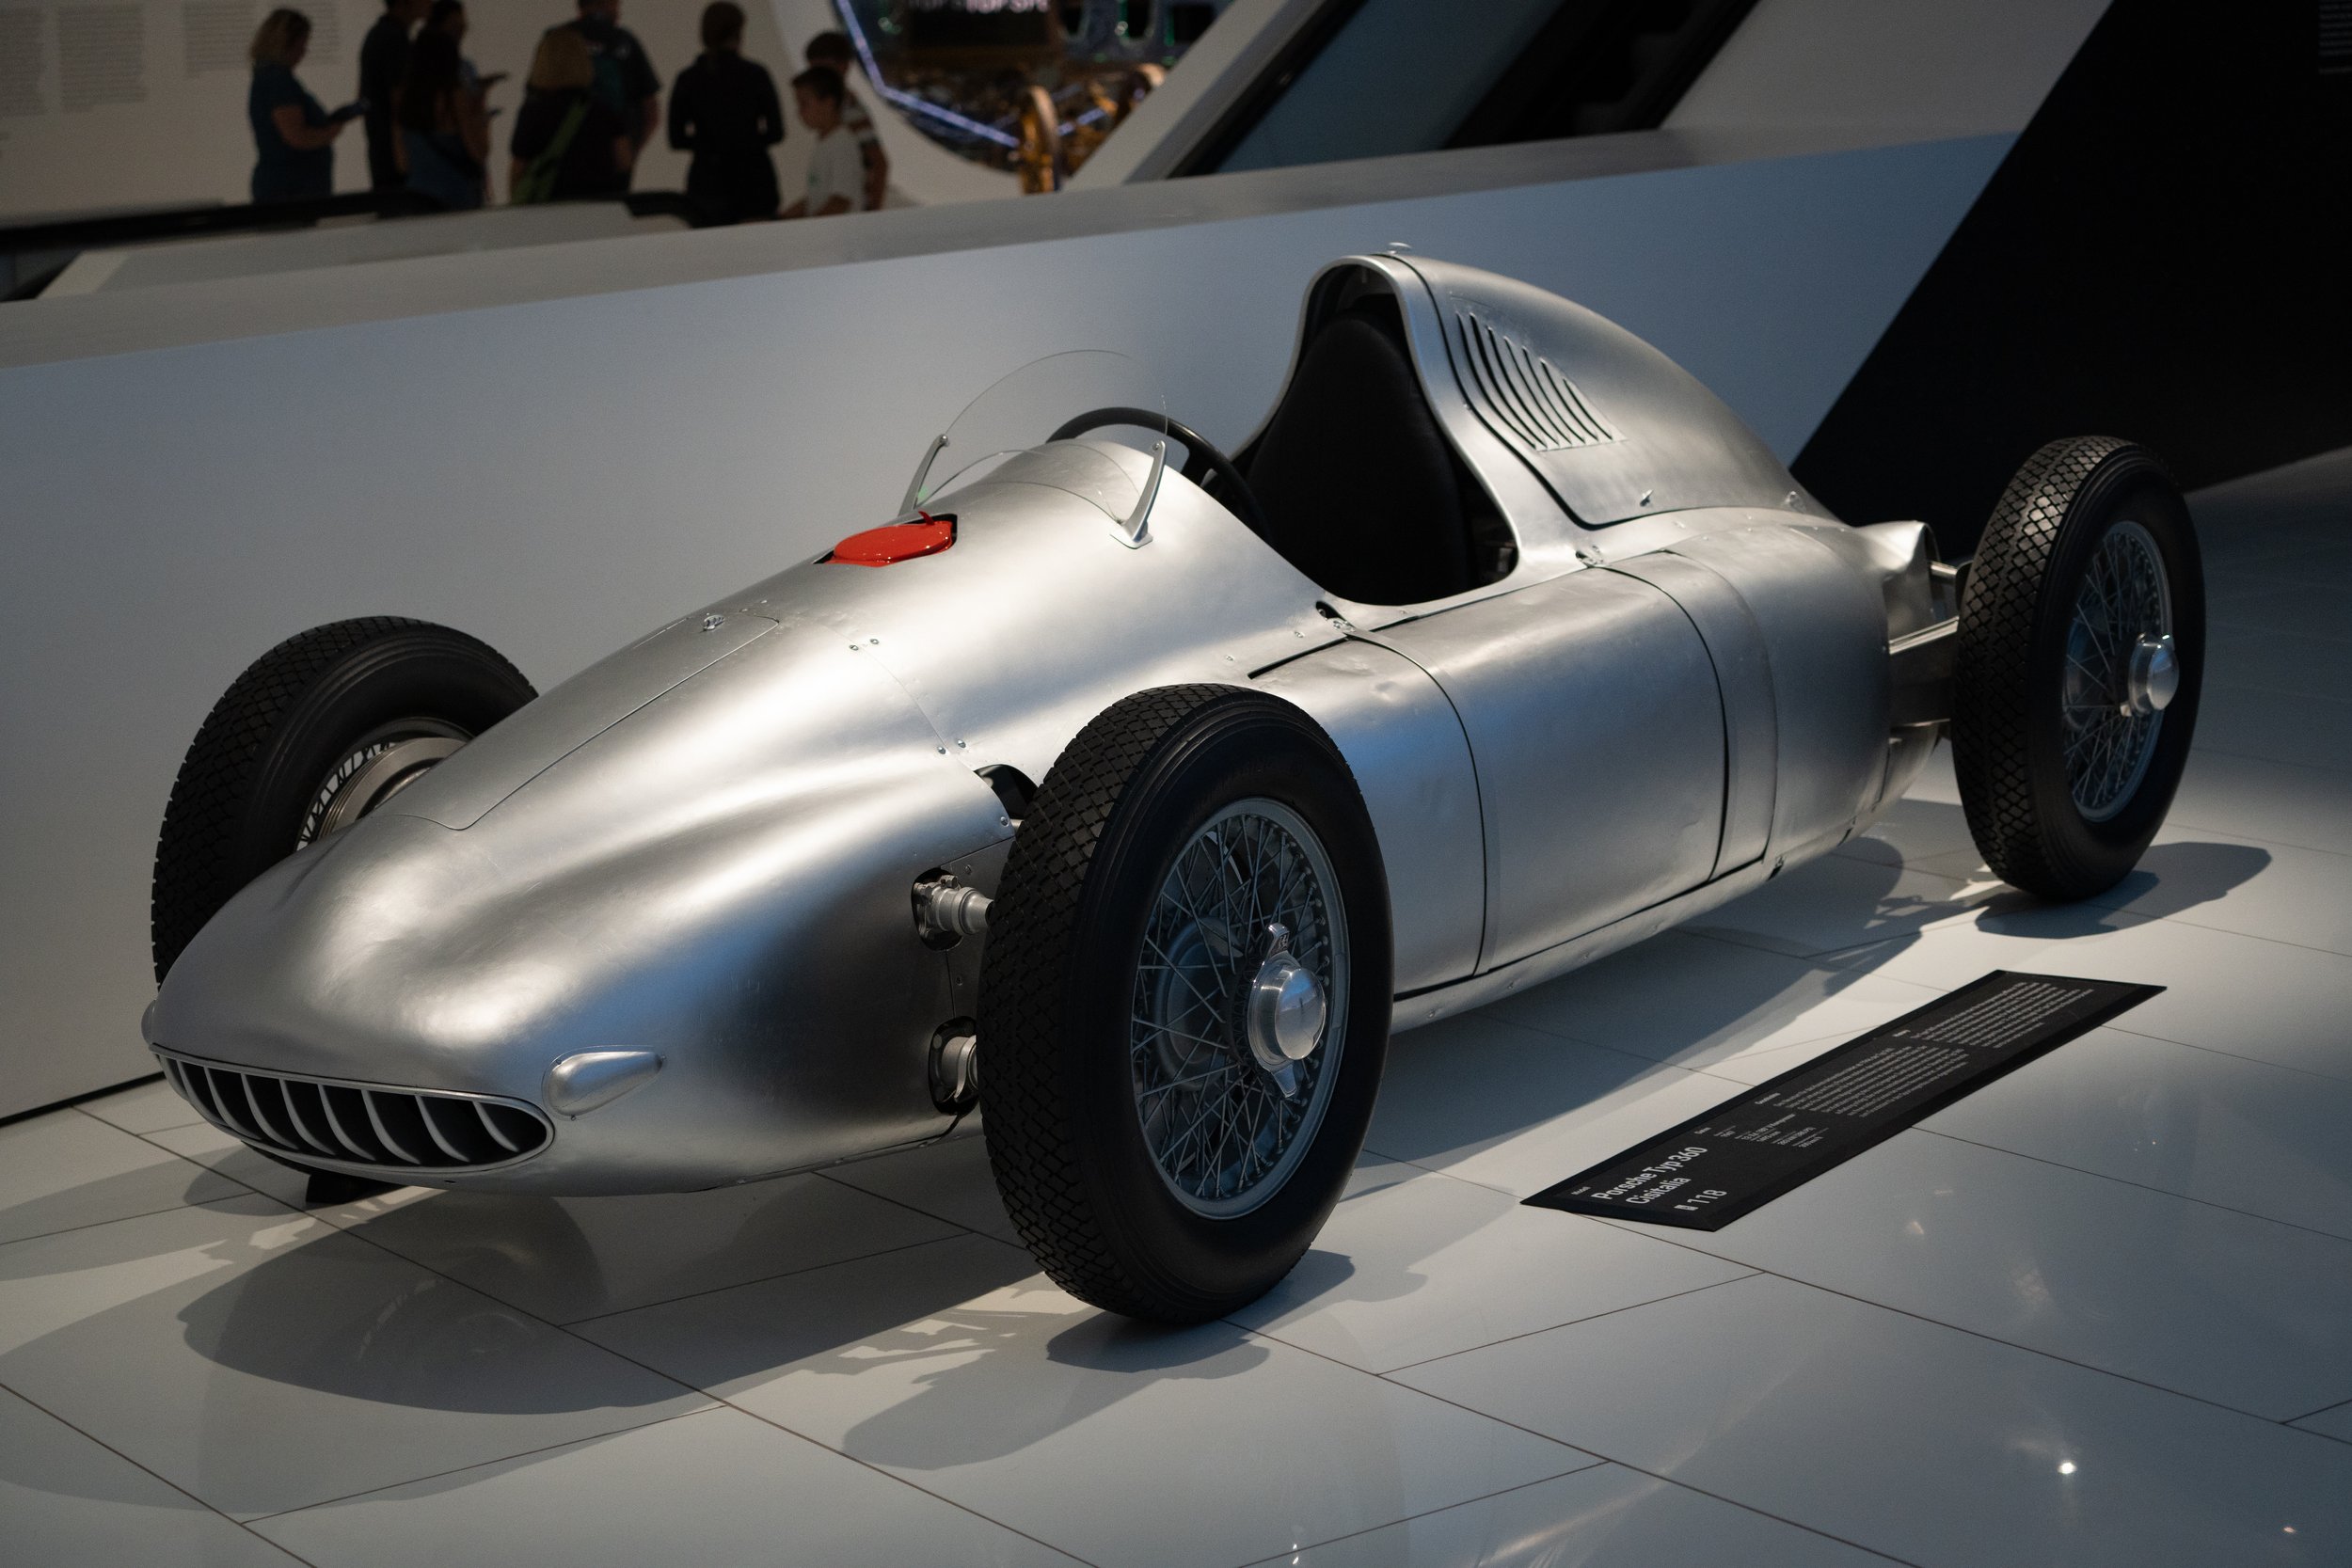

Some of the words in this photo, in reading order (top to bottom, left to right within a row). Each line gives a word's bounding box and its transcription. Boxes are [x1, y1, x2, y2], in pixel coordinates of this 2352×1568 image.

[1592, 1173, 1658, 1199] Porsche
[1642, 1161, 1684, 1173] Typ
[1668, 1147, 1708, 1162] 360
[1626, 1177, 1692, 1204] Cisitalia
[1687, 1189, 1727, 1204] 118
